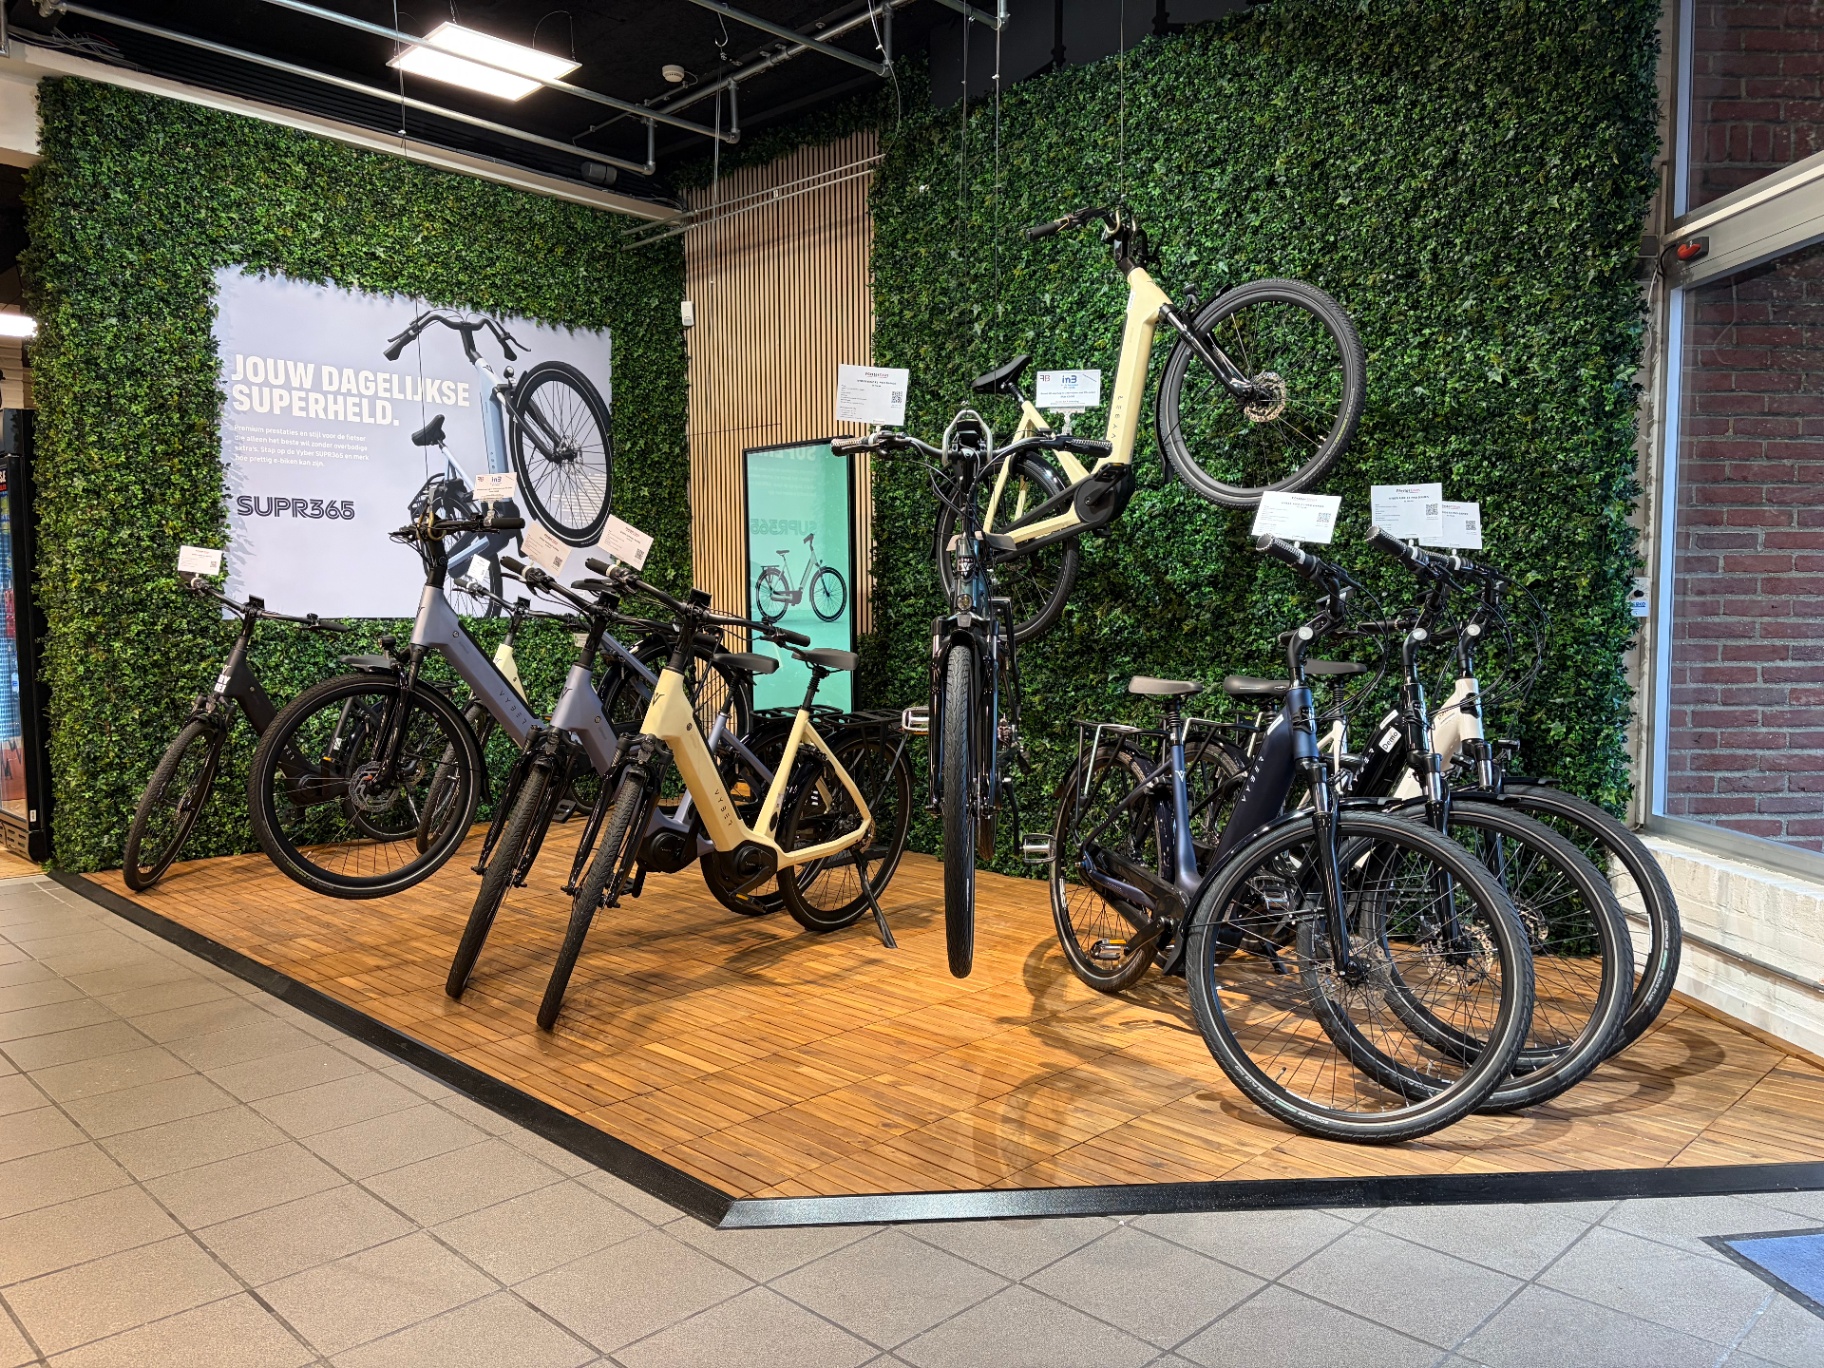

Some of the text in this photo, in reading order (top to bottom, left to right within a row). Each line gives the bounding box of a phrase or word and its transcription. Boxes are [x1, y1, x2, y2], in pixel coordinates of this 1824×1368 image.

[231, 353, 470, 407] JOUW DAGELIJKSE
[1062, 374, 1078, 384] in3
[232, 383, 400, 427] SUPERHELD.
[234, 424, 264, 433] Premium
[265, 427, 299, 437] prestaties
[309, 429, 321, 439] stijl
[337, 432, 345, 440] de
[346, 433, 366, 442] fietser
[247, 435, 268, 443] alleen
[268, 437, 280, 445] het
[281, 438, 299, 446] beste
[300, 439, 310, 447] wil
[311, 440, 333, 448] zonder
[333, 443, 368, 452] overbodige
[249, 455, 273, 464] prettig
[274, 457, 298, 465] e-biken
[298, 458, 311, 466] kan
[260, 446, 276, 454] Stap
[277, 448, 285, 456] op
[286, 447, 296, 455] de
[316, 450, 343, 459] SUPR365
[353, 453, 369, 461] merk
[236, 495, 355, 521] SUPR365
[1382, 730, 1399, 751] Demo
